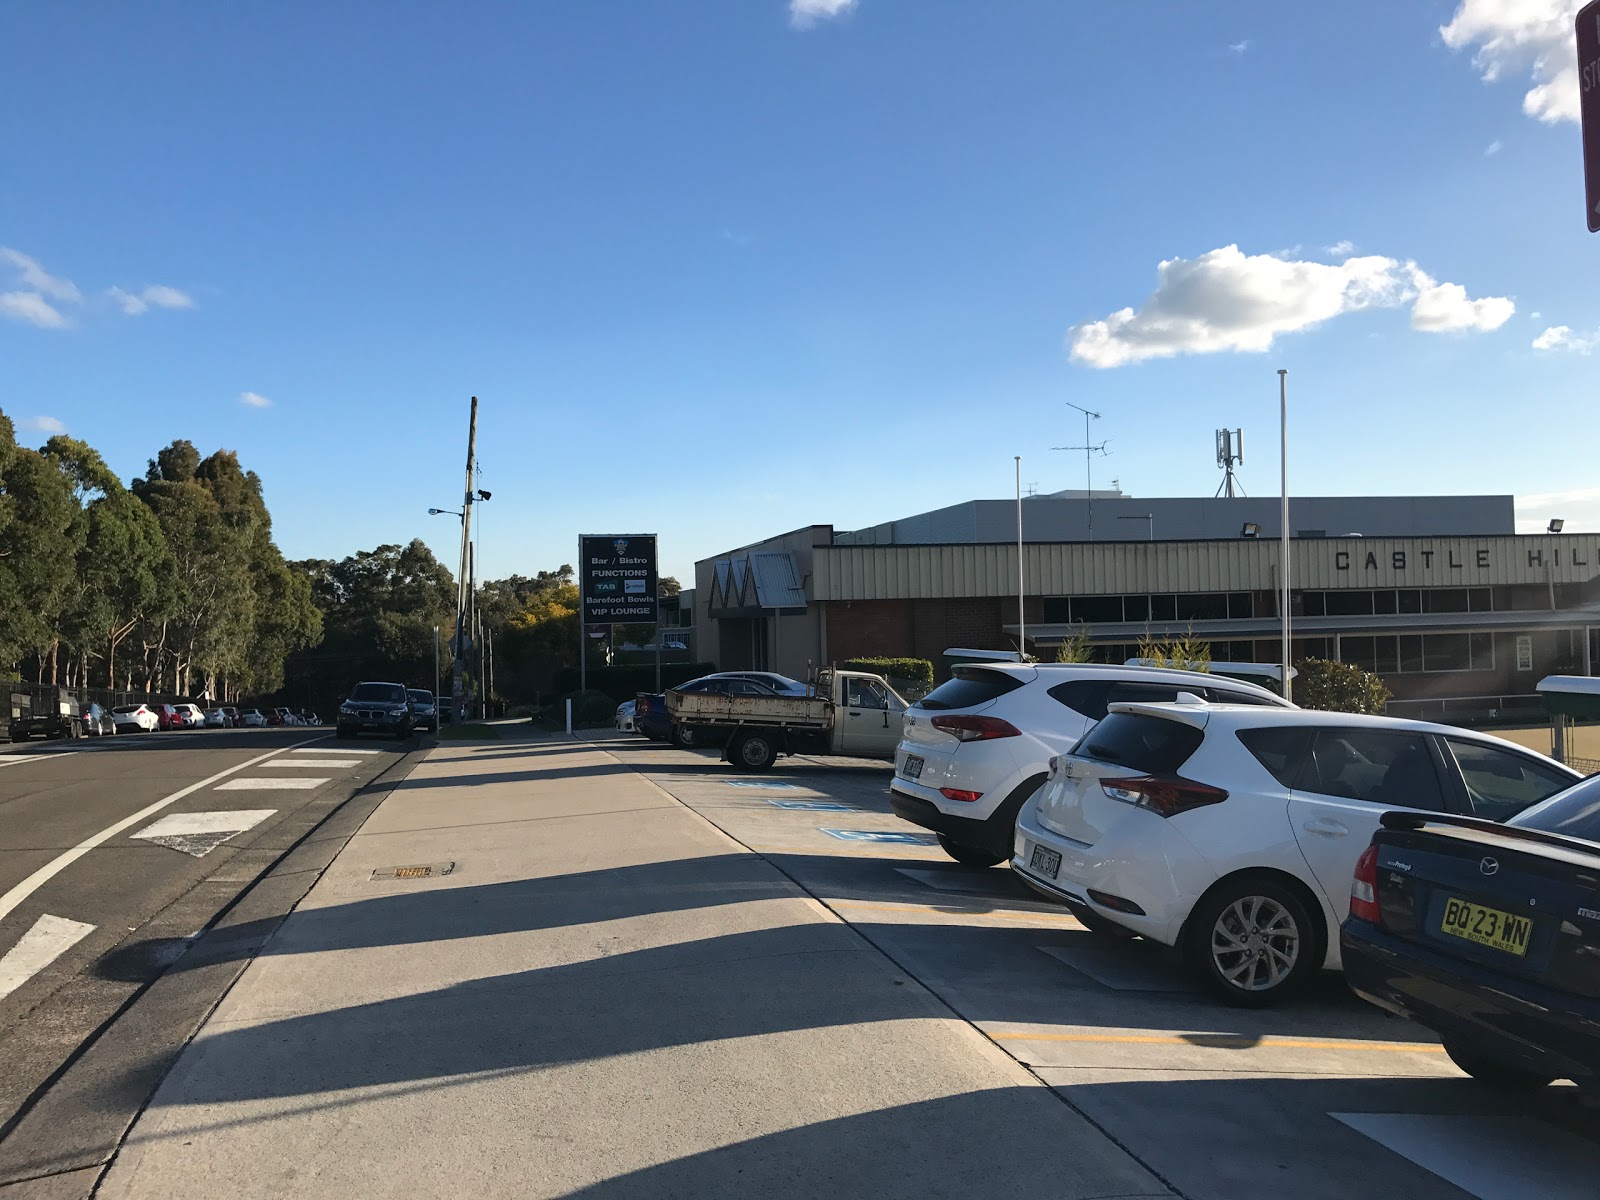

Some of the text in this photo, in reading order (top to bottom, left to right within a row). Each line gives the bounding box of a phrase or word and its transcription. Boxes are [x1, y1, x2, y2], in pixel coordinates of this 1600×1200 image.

[1335, 547, 1600, 570] CASTLE HIL
[1449, 927, 1515, 952] NEW SOUTH WALES
